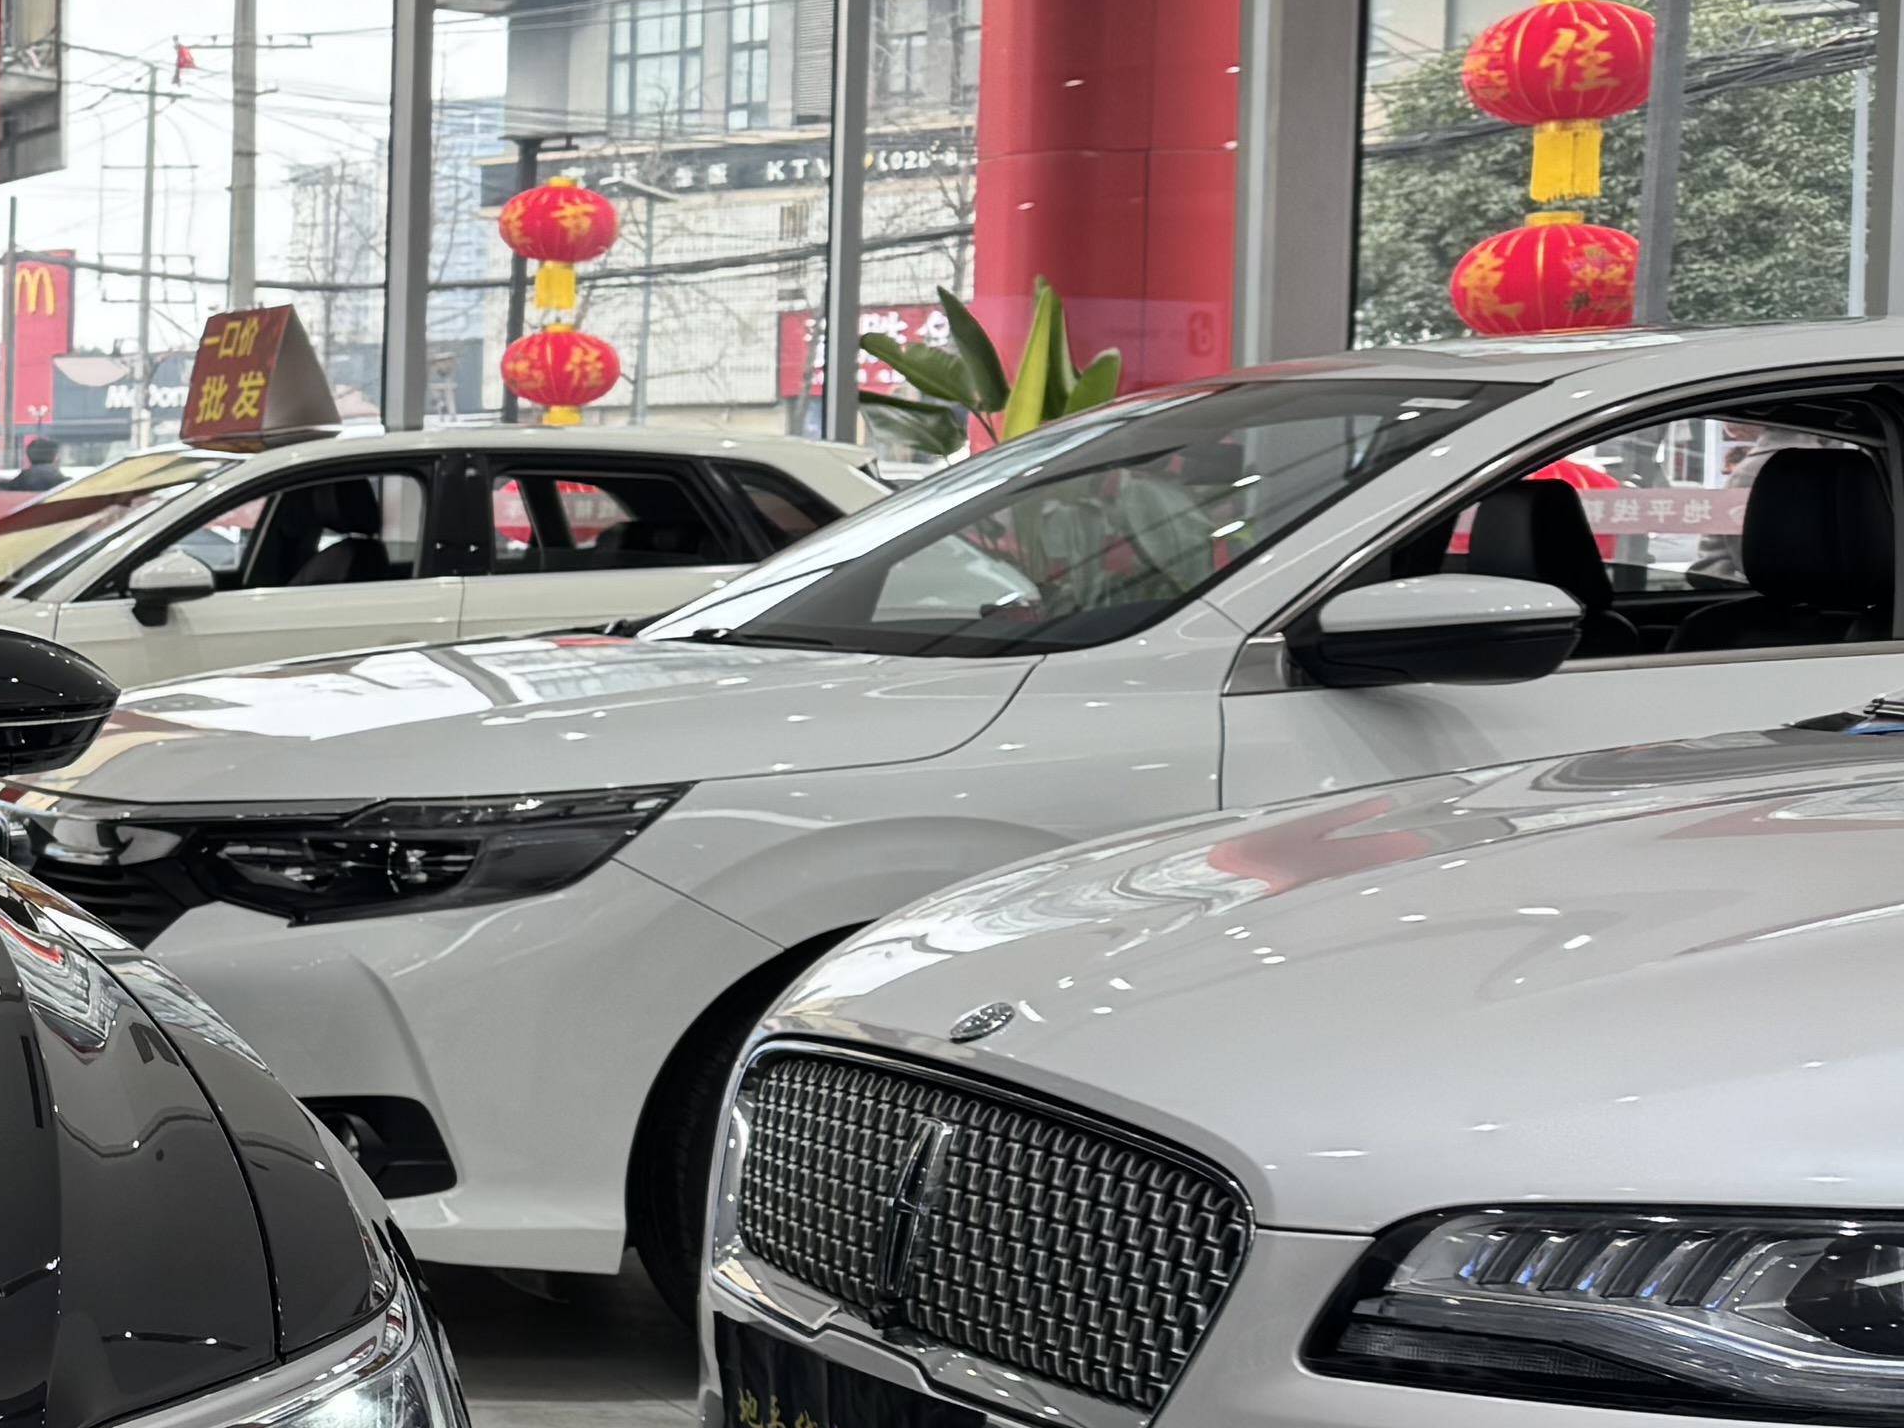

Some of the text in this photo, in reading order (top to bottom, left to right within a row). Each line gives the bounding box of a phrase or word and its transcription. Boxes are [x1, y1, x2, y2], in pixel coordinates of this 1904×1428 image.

[1540, 20, 1620, 91] 佳
[203, 316, 260, 359] 一口价
[195, 371, 267, 424] 批发
